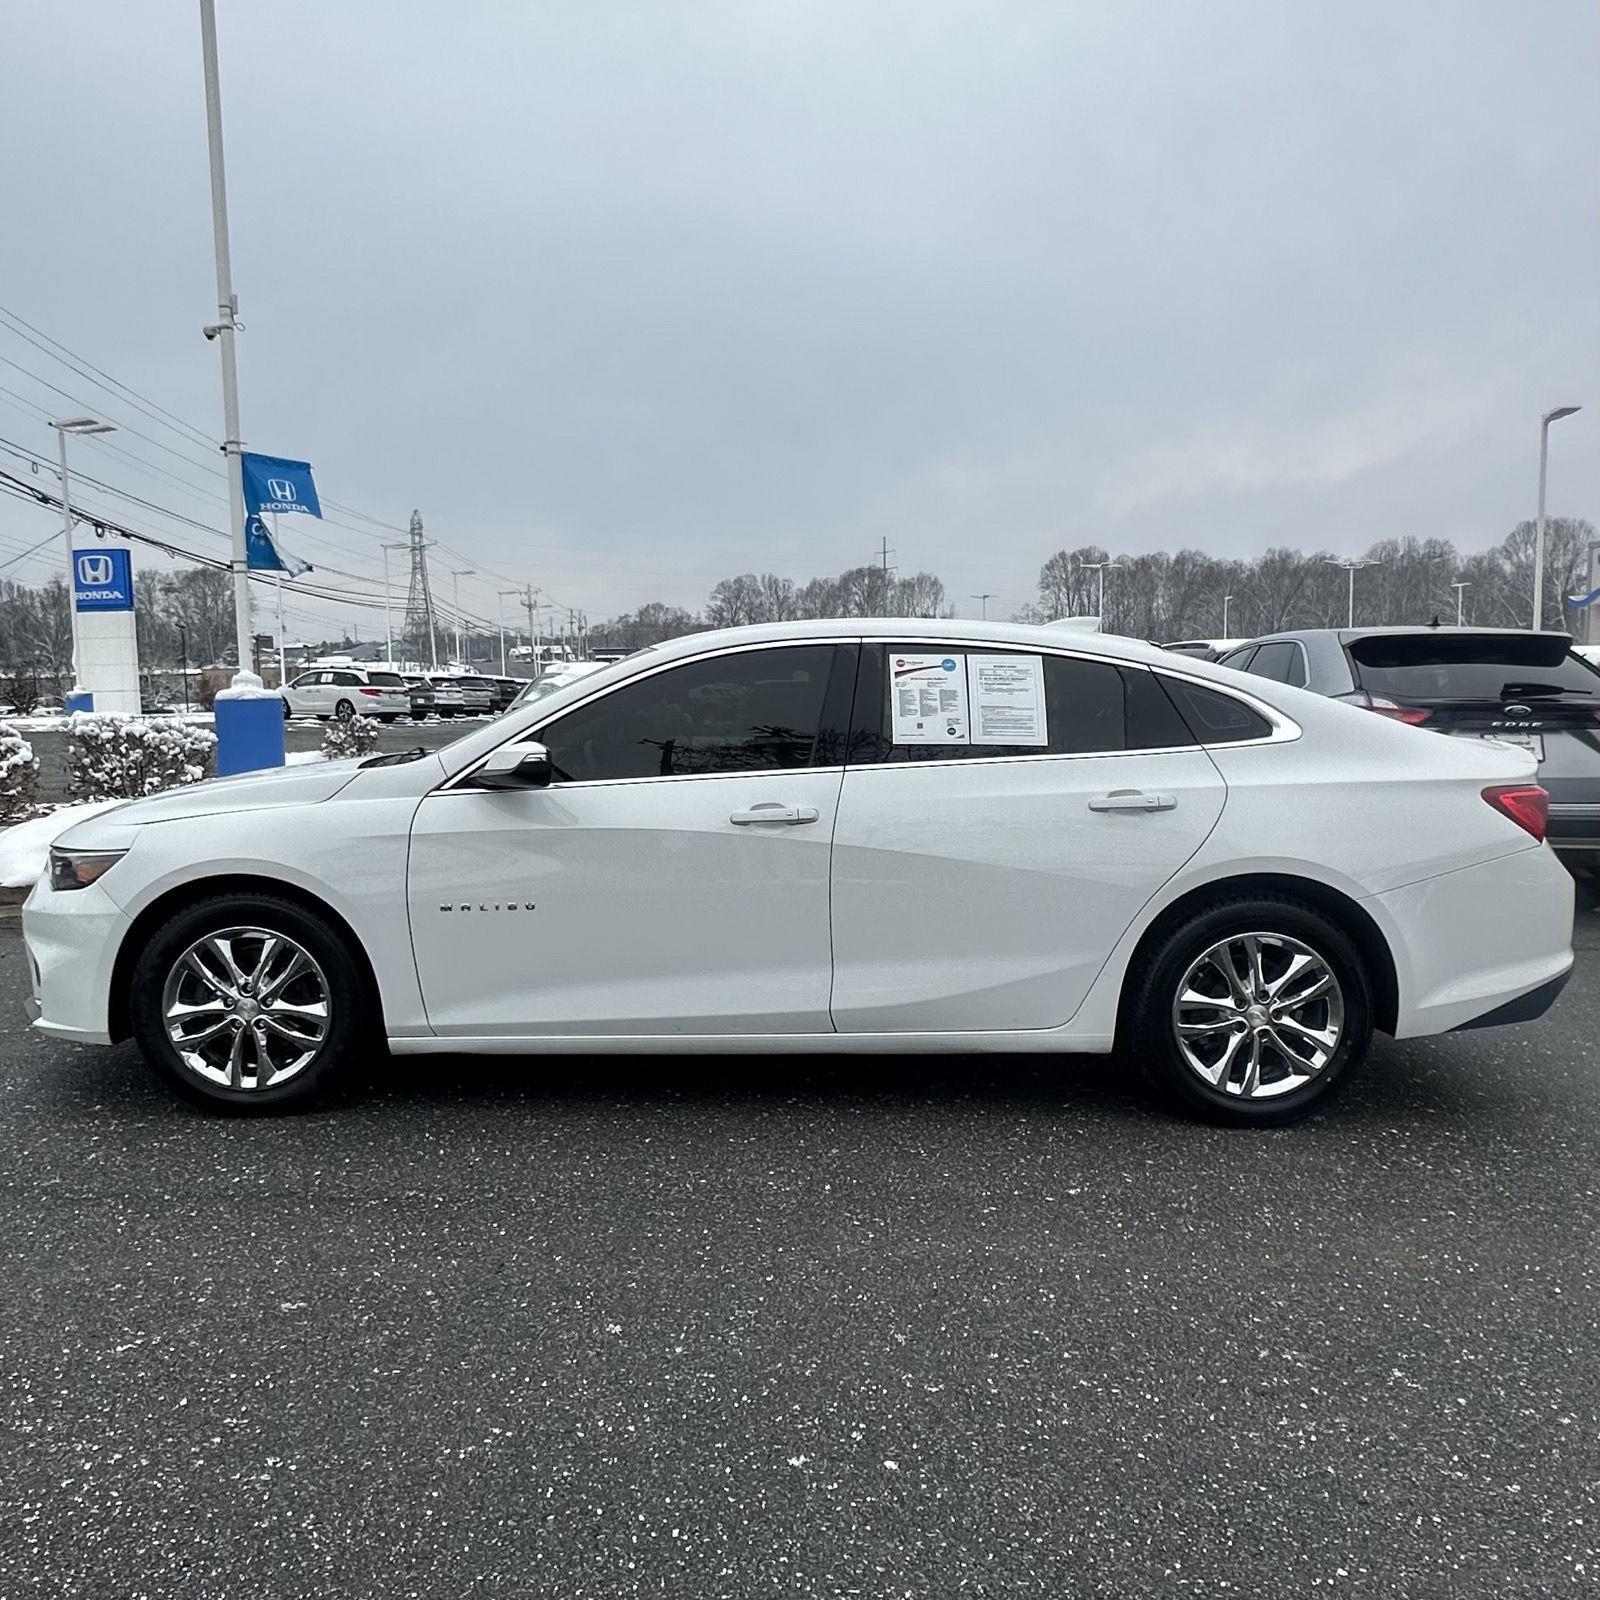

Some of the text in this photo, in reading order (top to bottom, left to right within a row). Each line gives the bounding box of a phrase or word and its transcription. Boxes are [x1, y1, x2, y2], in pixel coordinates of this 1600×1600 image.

[259, 502, 311, 512] HONDA
[75, 590, 124, 601] HONDA
[439, 902, 536, 912] MALIBU
